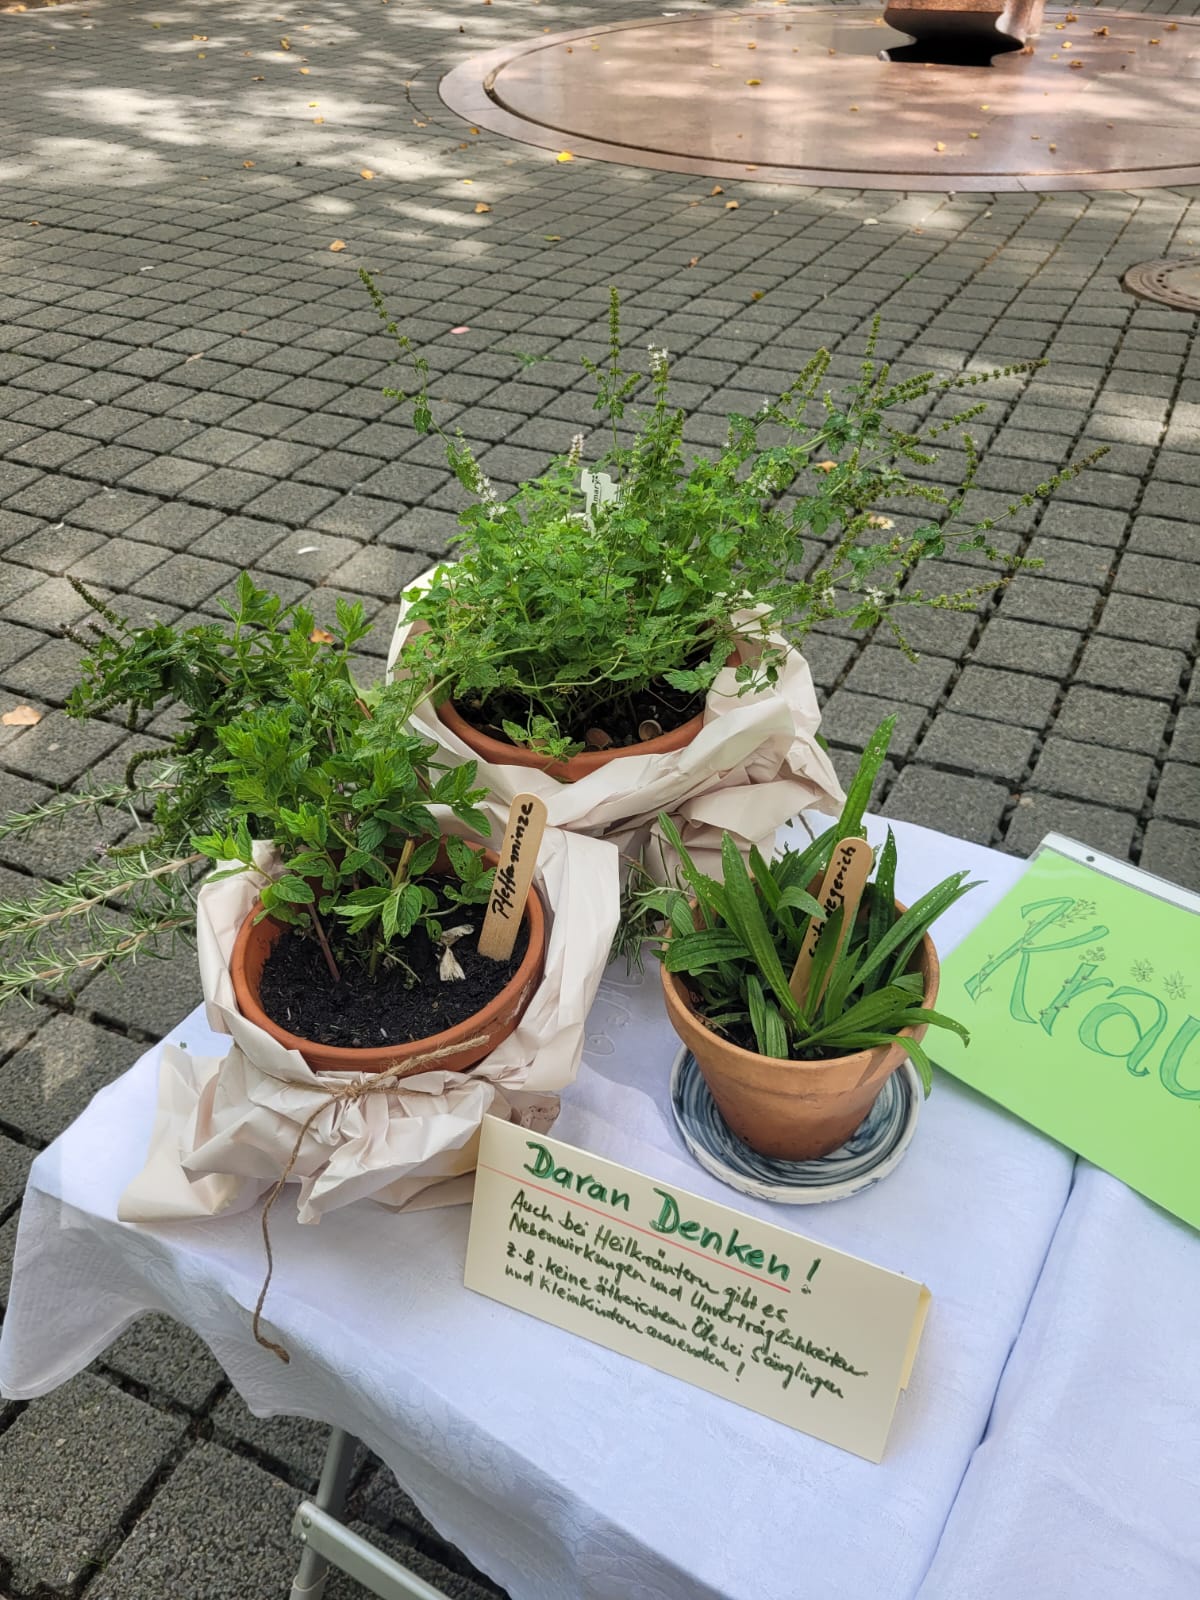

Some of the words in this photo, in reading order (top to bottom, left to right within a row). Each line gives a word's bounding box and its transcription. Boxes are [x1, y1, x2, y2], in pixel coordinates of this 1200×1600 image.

[510, 1188, 554, 1223] Auch
[558, 1210, 589, 1237] bei
[593, 1224, 719, 1294] Heilkräutern
[723, 1286, 758, 1317] gibt
[762, 1304, 789, 1323] es
[523, 1140, 631, 1211] Daran
[649, 1187, 791, 1282] Denken
[505, 1263, 534, 1287] und
[644, 1325, 729, 1373] anwenden
[509, 1211, 647, 1286] Nebenwirkungen
[649, 1276, 682, 1302] und
[690, 1289, 869, 1377] Unverträglichkeiten
[545, 1255, 592, 1291] keine
[691, 1315, 719, 1347] Öle
[720, 1335, 744, 1357] bei
[751, 1345, 844, 1399] Säuglingen
